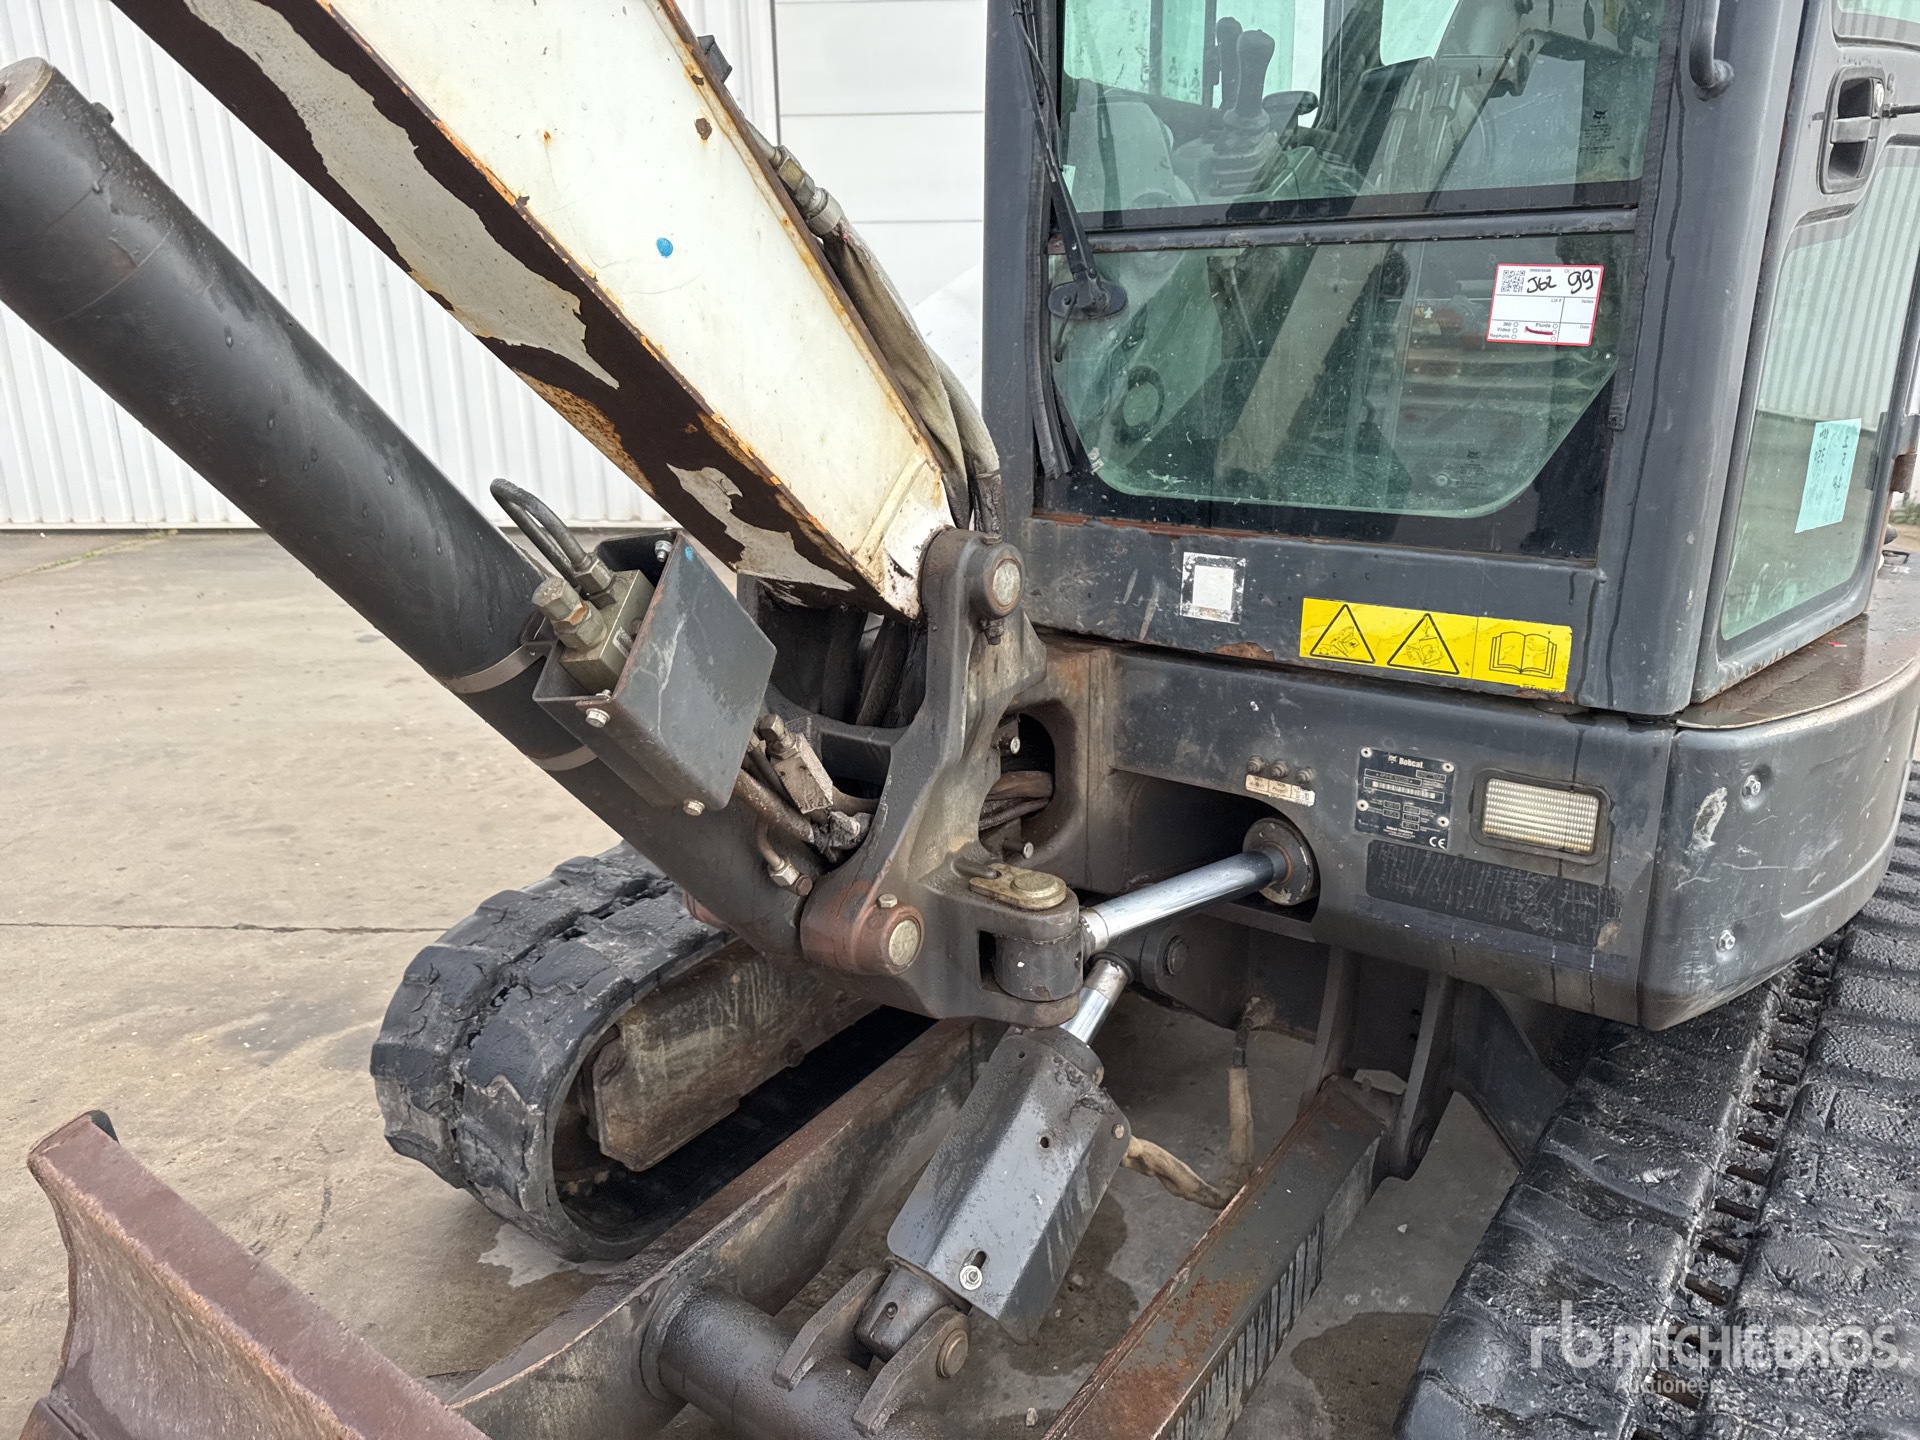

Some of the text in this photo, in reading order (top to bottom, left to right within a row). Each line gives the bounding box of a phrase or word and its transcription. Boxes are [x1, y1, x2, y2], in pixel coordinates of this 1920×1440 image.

[1567, 268, 1594, 295] 99
[1399, 757, 1424, 769] Bobcat
[1429, 837, 1446, 850] CE
